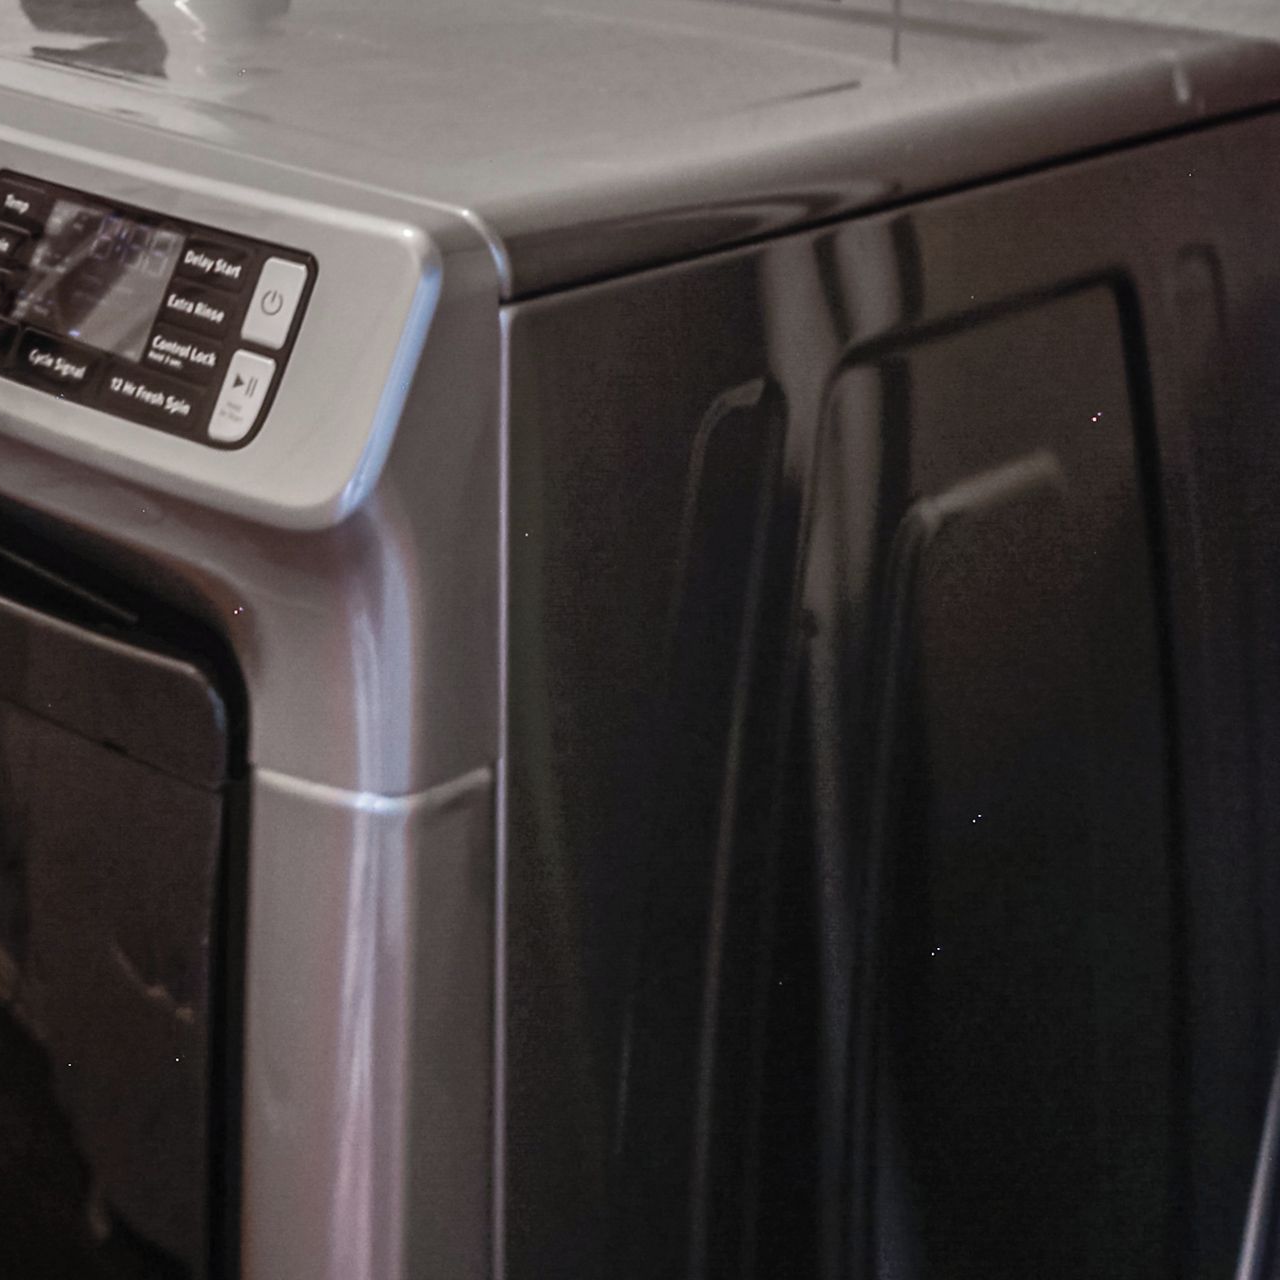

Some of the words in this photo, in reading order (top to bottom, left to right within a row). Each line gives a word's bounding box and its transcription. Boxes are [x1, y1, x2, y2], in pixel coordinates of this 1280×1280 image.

[4, 193, 30, 214] Temp
[183, 249, 215, 272] Delay
[215, 257, 242, 279] Start
[166, 293, 194, 311] Extra
[195, 301, 225, 325] Rinse
[28, 348, 54, 368] Cycle
[54, 357, 87, 380] Signal
[152, 334, 190, 360] Control
[191, 347, 217, 368] Lock
[110, 376, 122, 391] 12
[124, 381, 136, 395] Hr
[135, 384, 164, 405] Fresh
[165, 395, 191, 417] Spin
